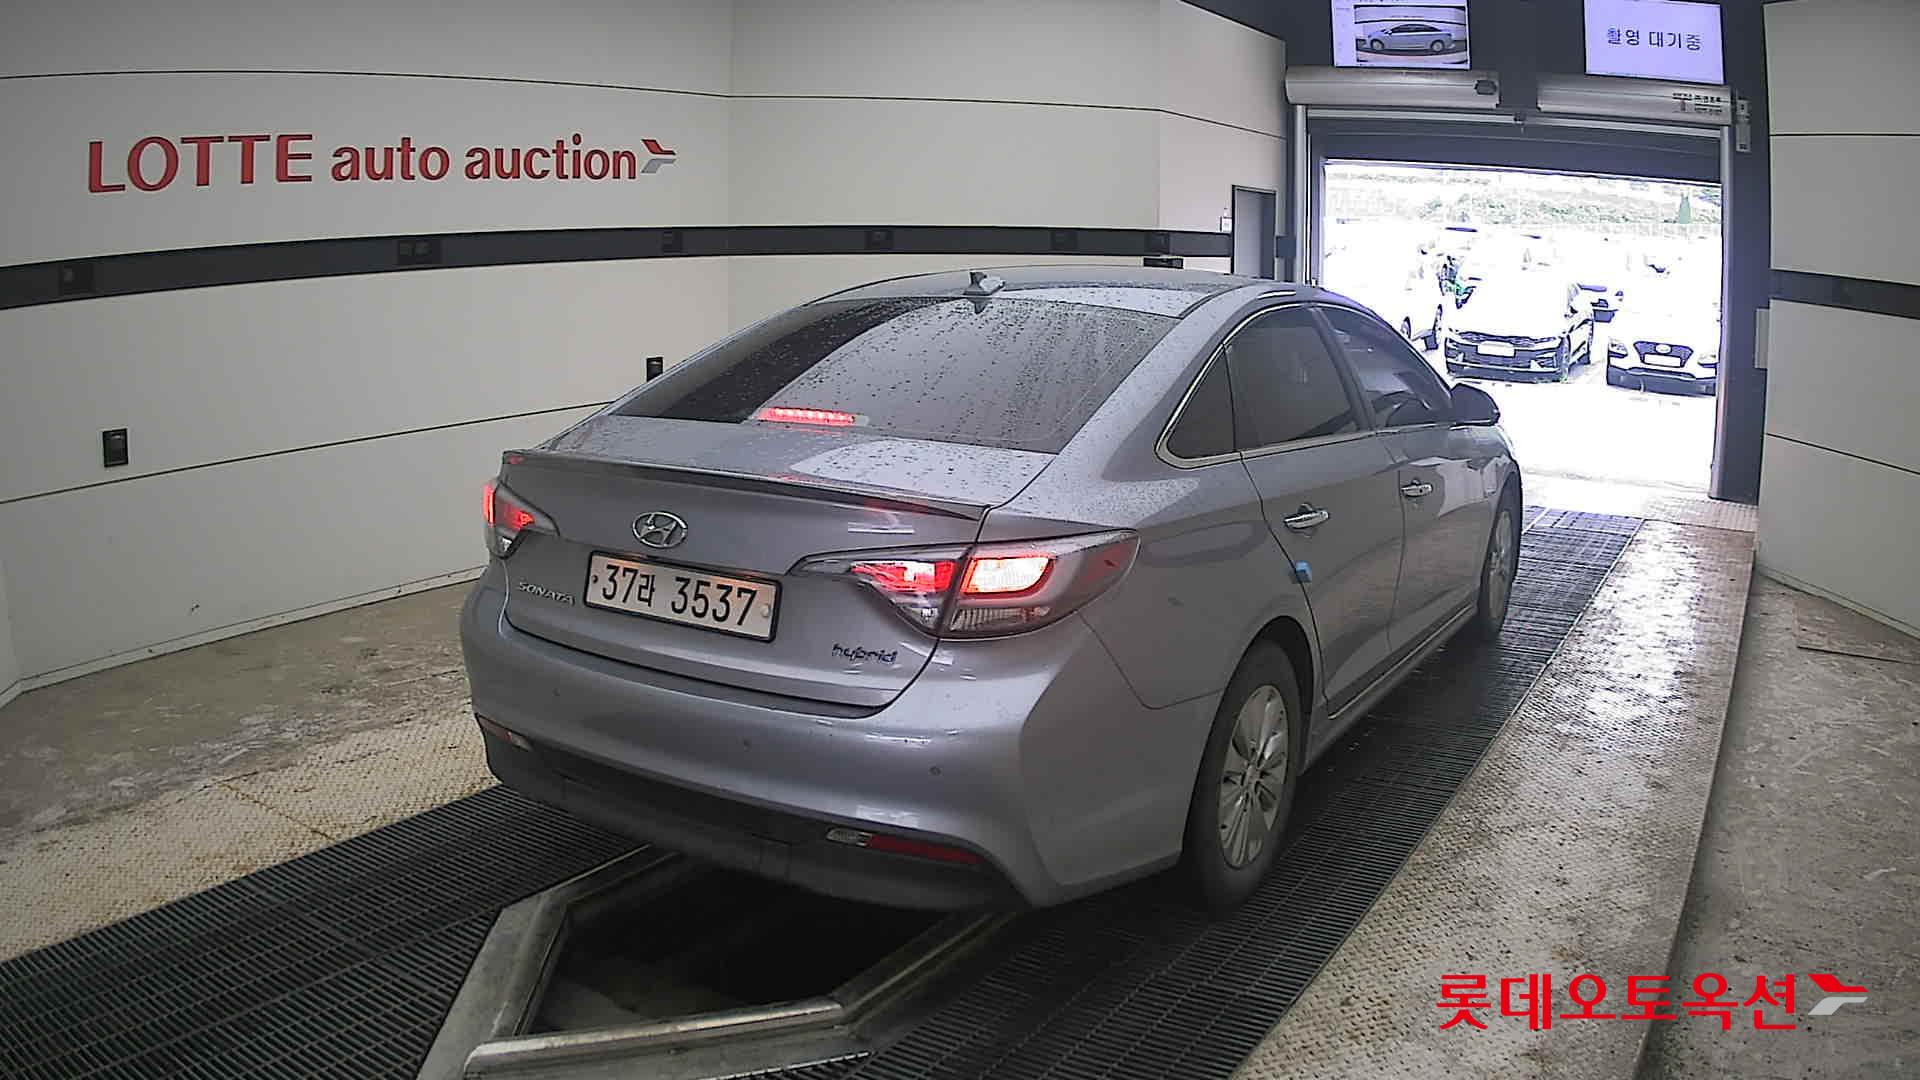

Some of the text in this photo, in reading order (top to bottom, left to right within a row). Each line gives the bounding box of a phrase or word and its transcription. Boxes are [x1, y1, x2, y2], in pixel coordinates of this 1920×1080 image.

[1648, 31, 1701, 51] 대기중
[88, 133, 638, 194] LOTTE auto auction
[519, 581, 575, 606] SONATA
[601, 563, 758, 626] 37라 3537
[832, 643, 898, 663] hybrid
